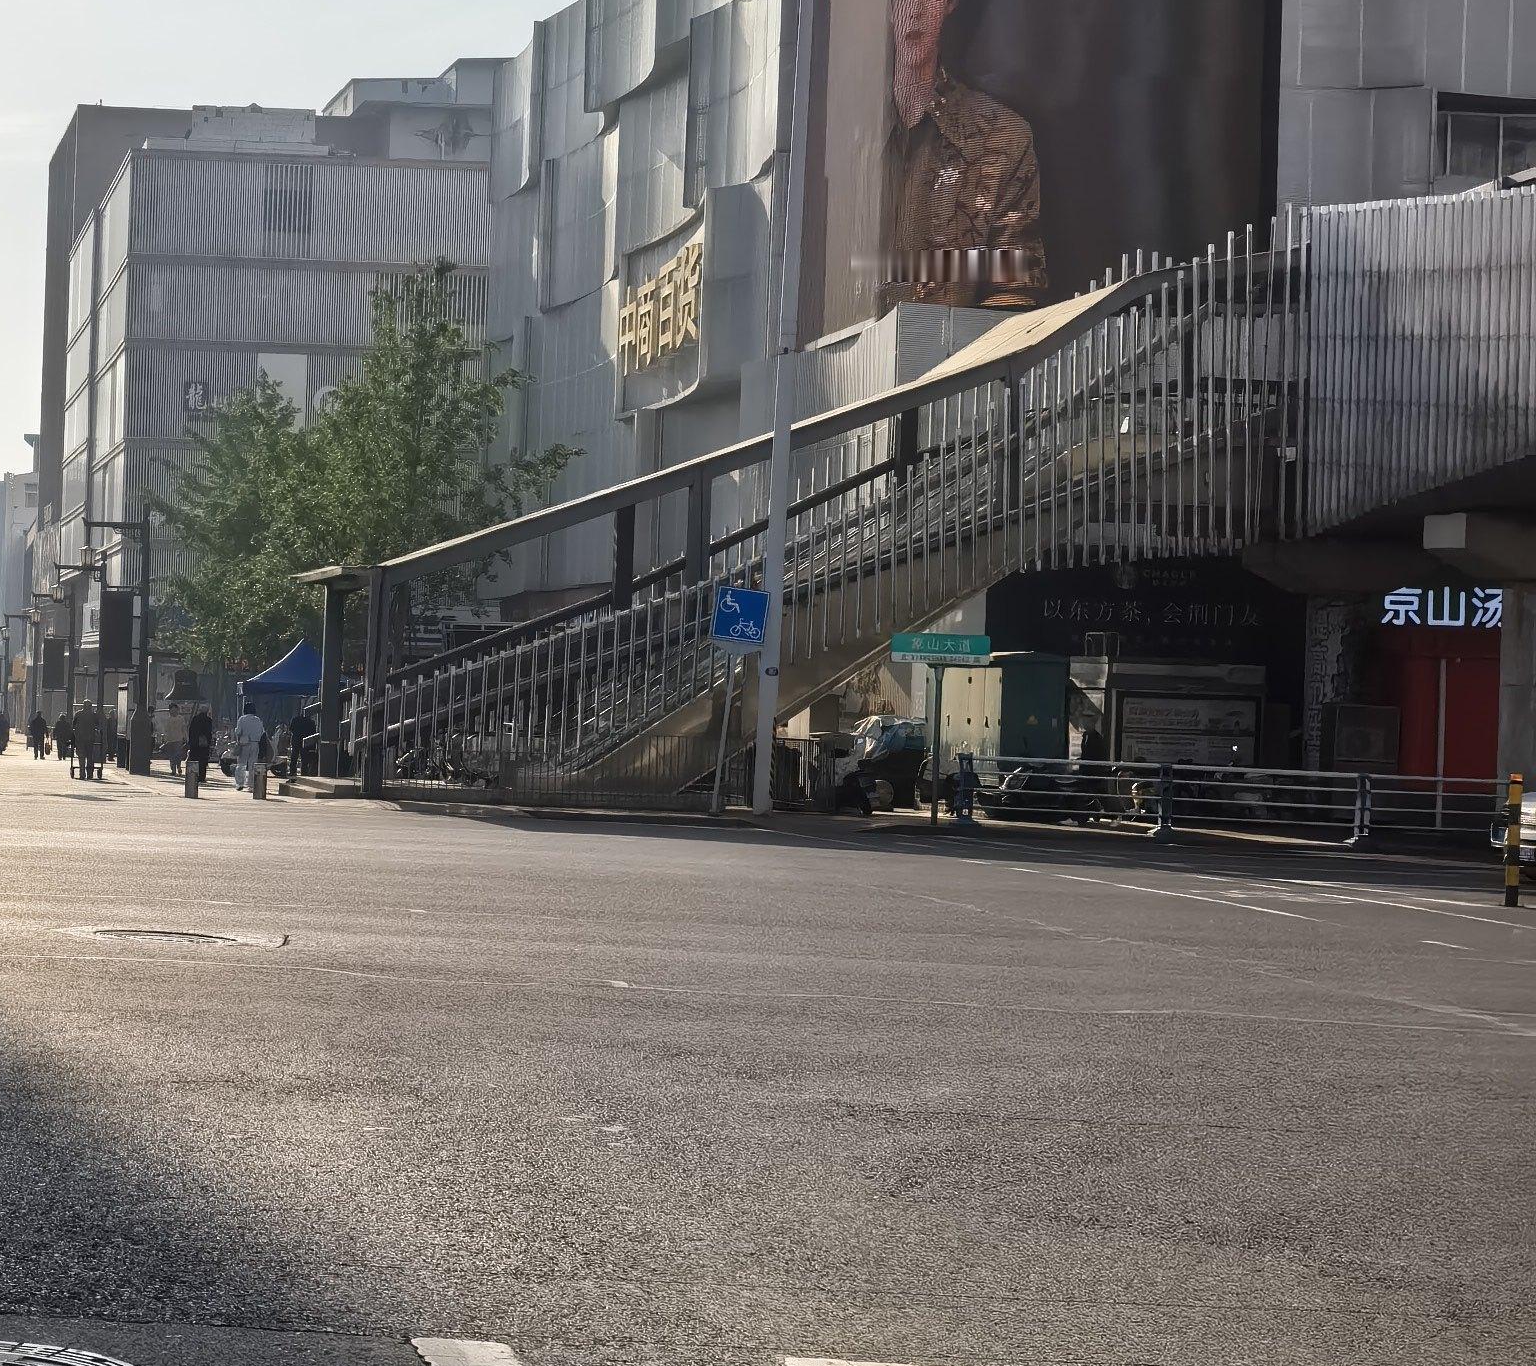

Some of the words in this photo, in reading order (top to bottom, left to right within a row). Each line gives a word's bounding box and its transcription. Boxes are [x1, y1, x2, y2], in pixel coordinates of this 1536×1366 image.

[618, 242, 704, 377] 中商百货
[1381, 586, 1503, 629] 京山汤
